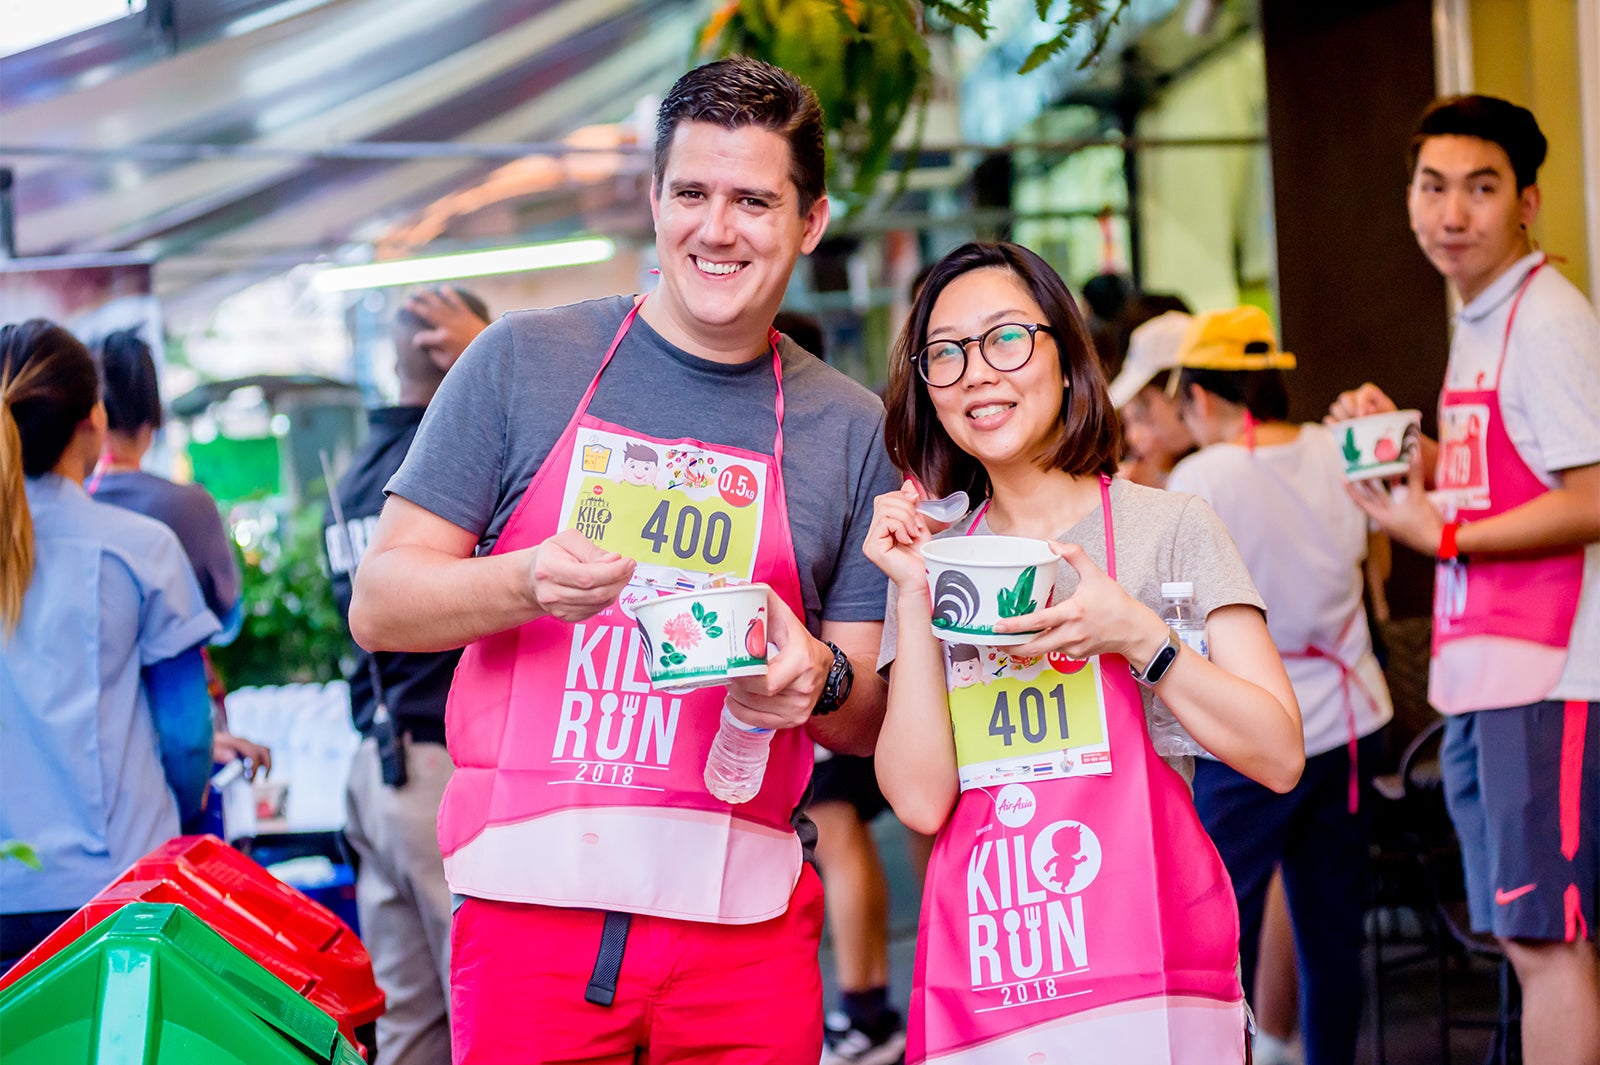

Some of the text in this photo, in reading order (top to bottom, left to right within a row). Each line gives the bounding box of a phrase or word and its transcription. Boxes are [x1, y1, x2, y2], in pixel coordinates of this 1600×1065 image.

[576, 522, 606, 541] RUN
[577, 505, 613, 524] KILO
[640, 499, 732, 565] 400
[565, 624, 654, 693] KIL
[552, 691, 683, 766] RUN
[988, 683, 1070, 747] 401
[574, 763, 635, 786] 2018
[967, 820, 1103, 915] KILO
[969, 895, 1089, 987] RUN
[1000, 978, 1058, 1006] 2018
